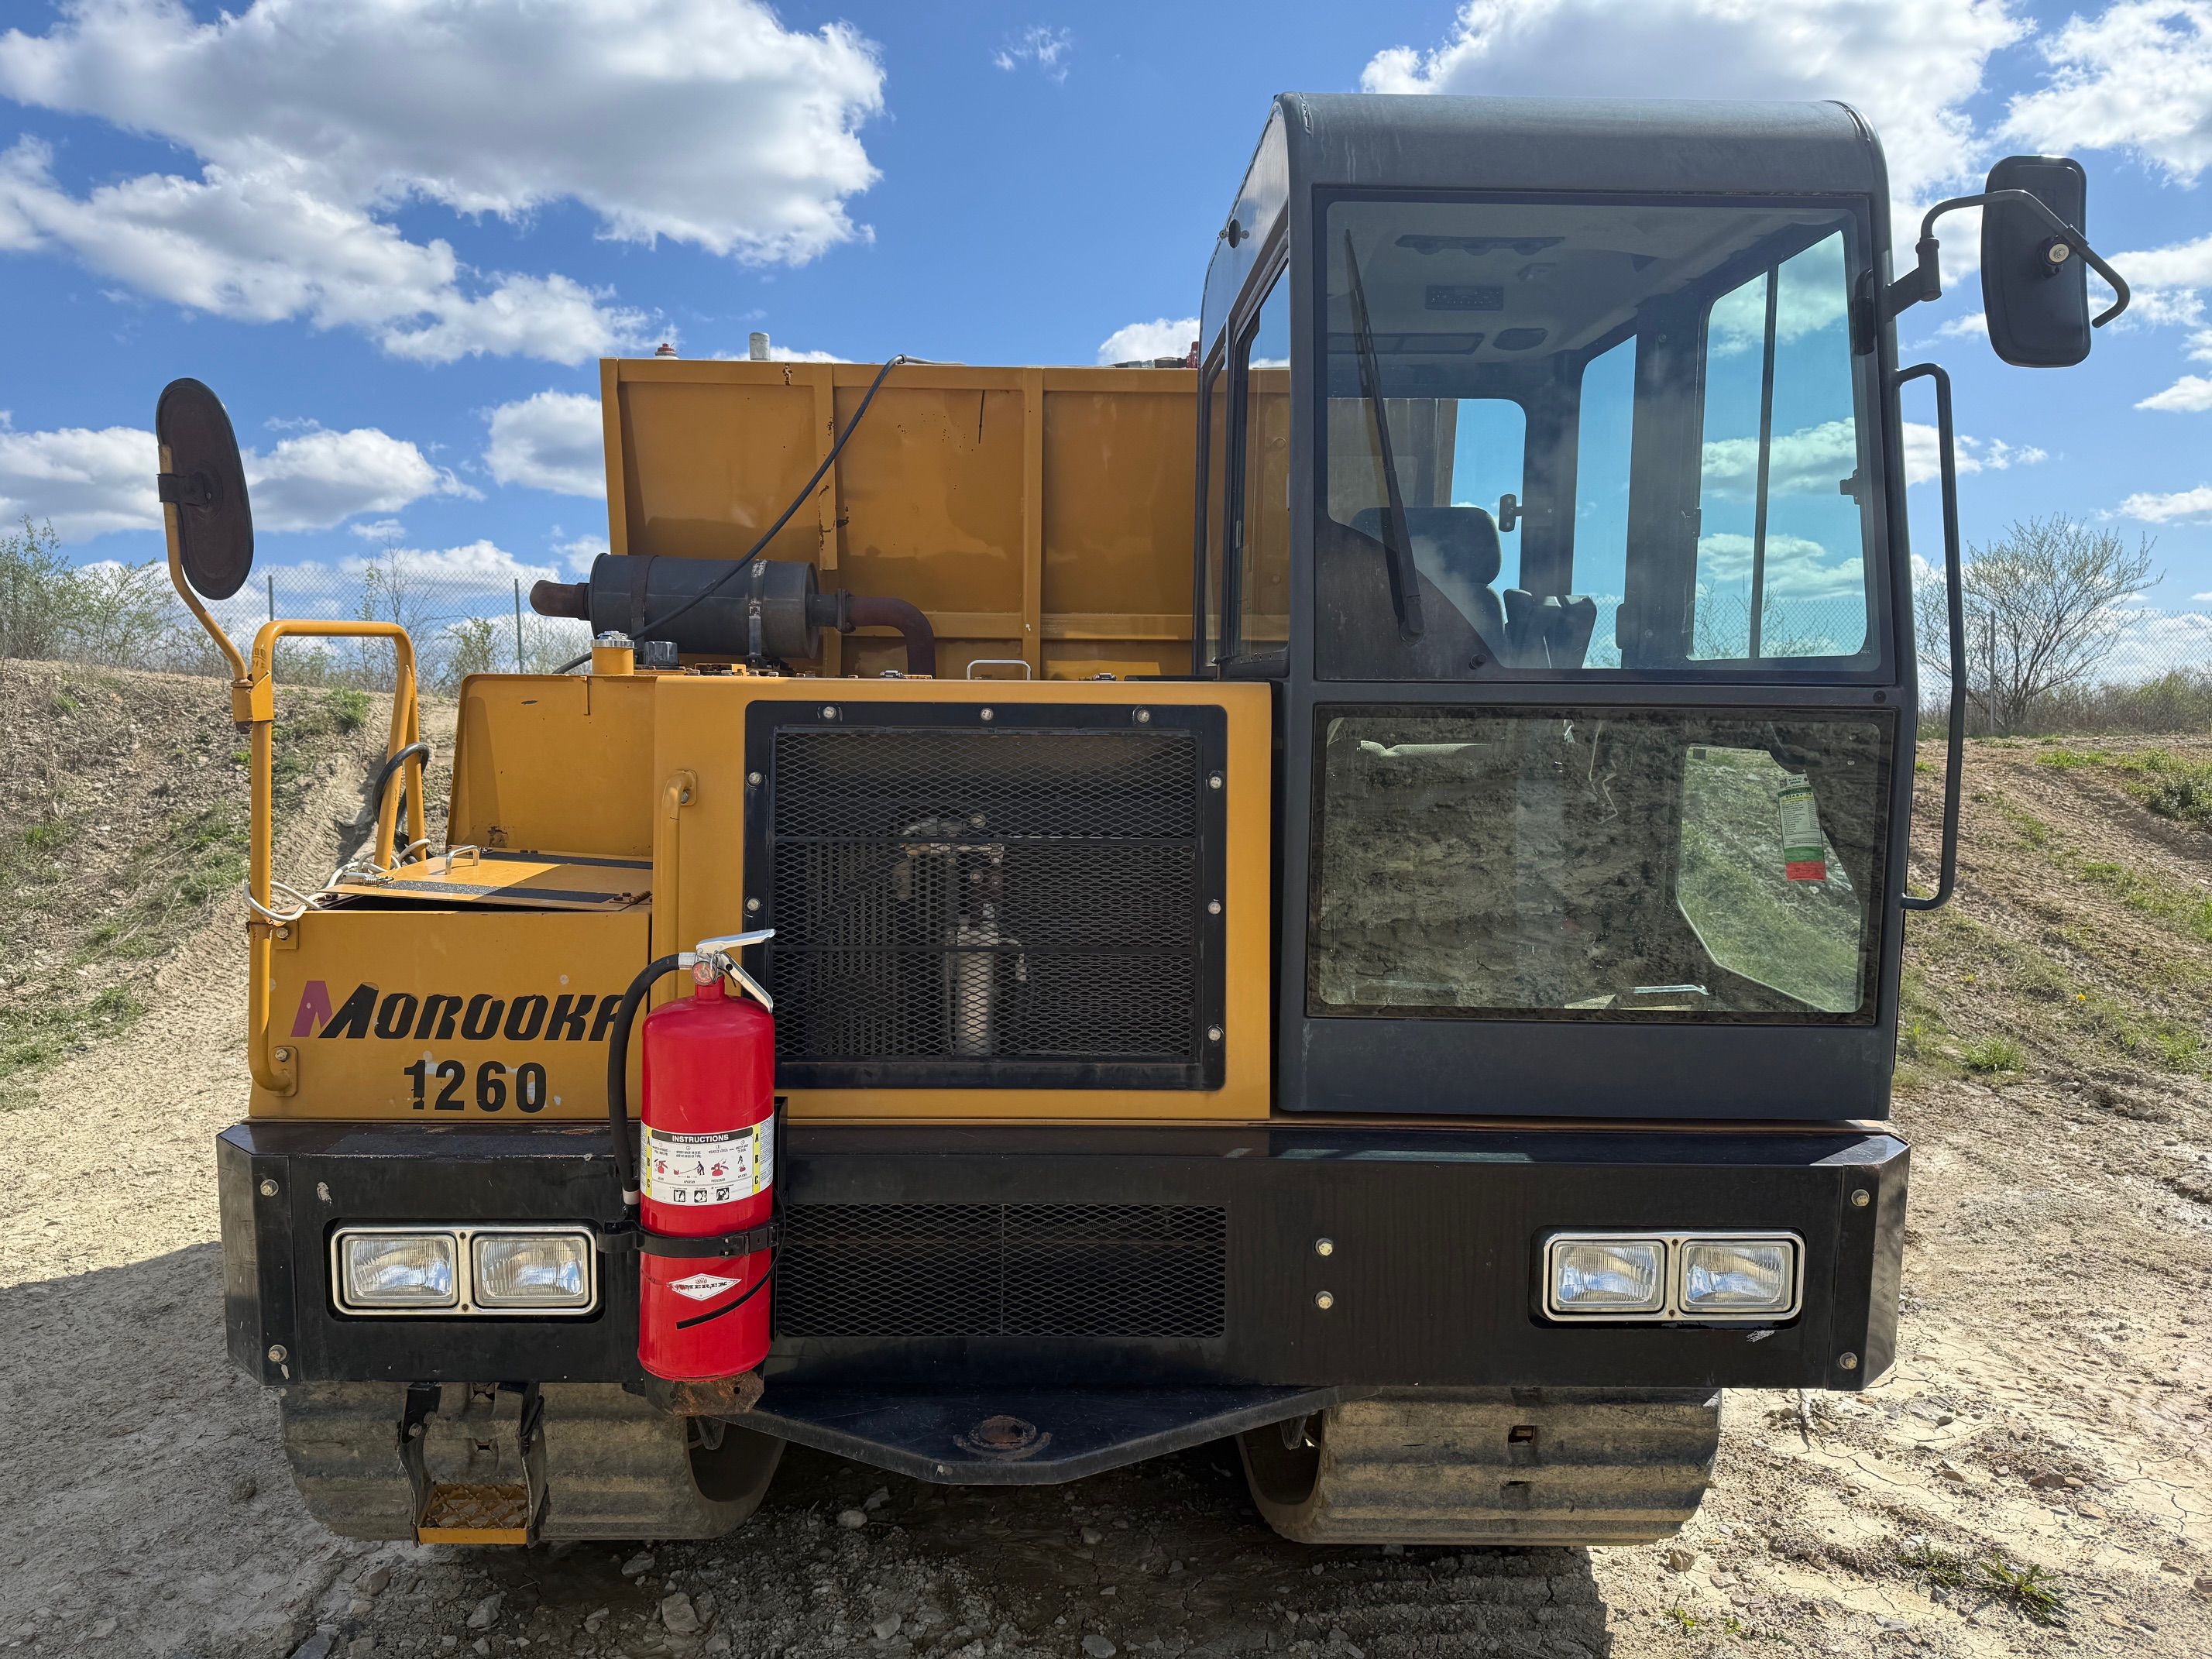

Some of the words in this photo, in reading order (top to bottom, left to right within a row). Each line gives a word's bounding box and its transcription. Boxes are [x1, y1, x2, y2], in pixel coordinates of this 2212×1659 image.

[404, 1060, 547, 1113] 1260
[672, 1133, 730, 1144] INSTRUCTIONS
[755, 1133, 759, 1142] A
[755, 1154, 759, 1163] B
[754, 1175, 759, 1184] C
